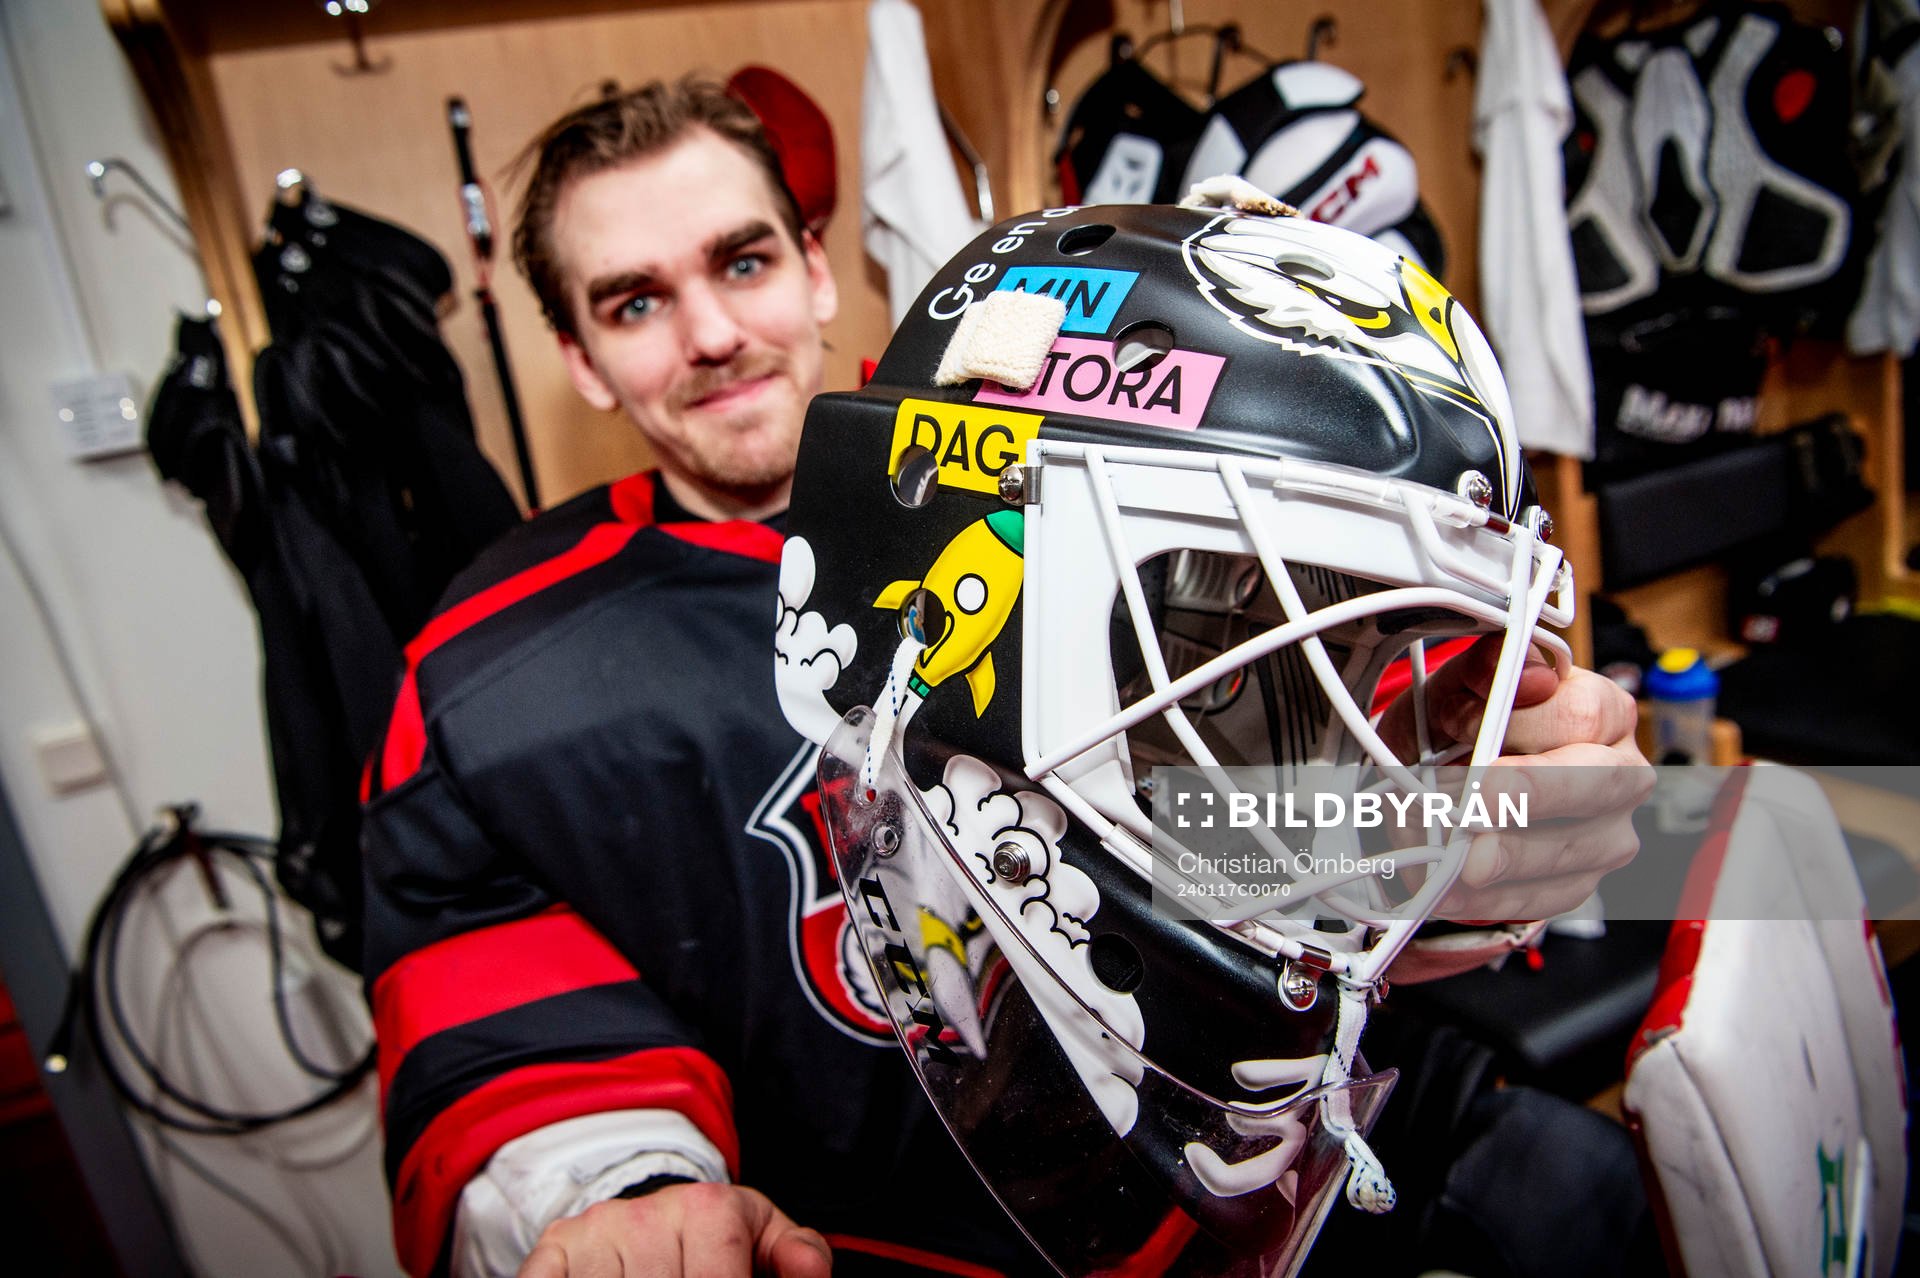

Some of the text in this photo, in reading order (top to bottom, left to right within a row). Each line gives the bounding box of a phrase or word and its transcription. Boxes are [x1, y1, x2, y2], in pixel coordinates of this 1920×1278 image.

[1306, 155, 1380, 224] CM
[928, 221, 1048, 320] Ge en
[1001, 351, 1182, 414] TORA
[910, 413, 1019, 477] DAG
